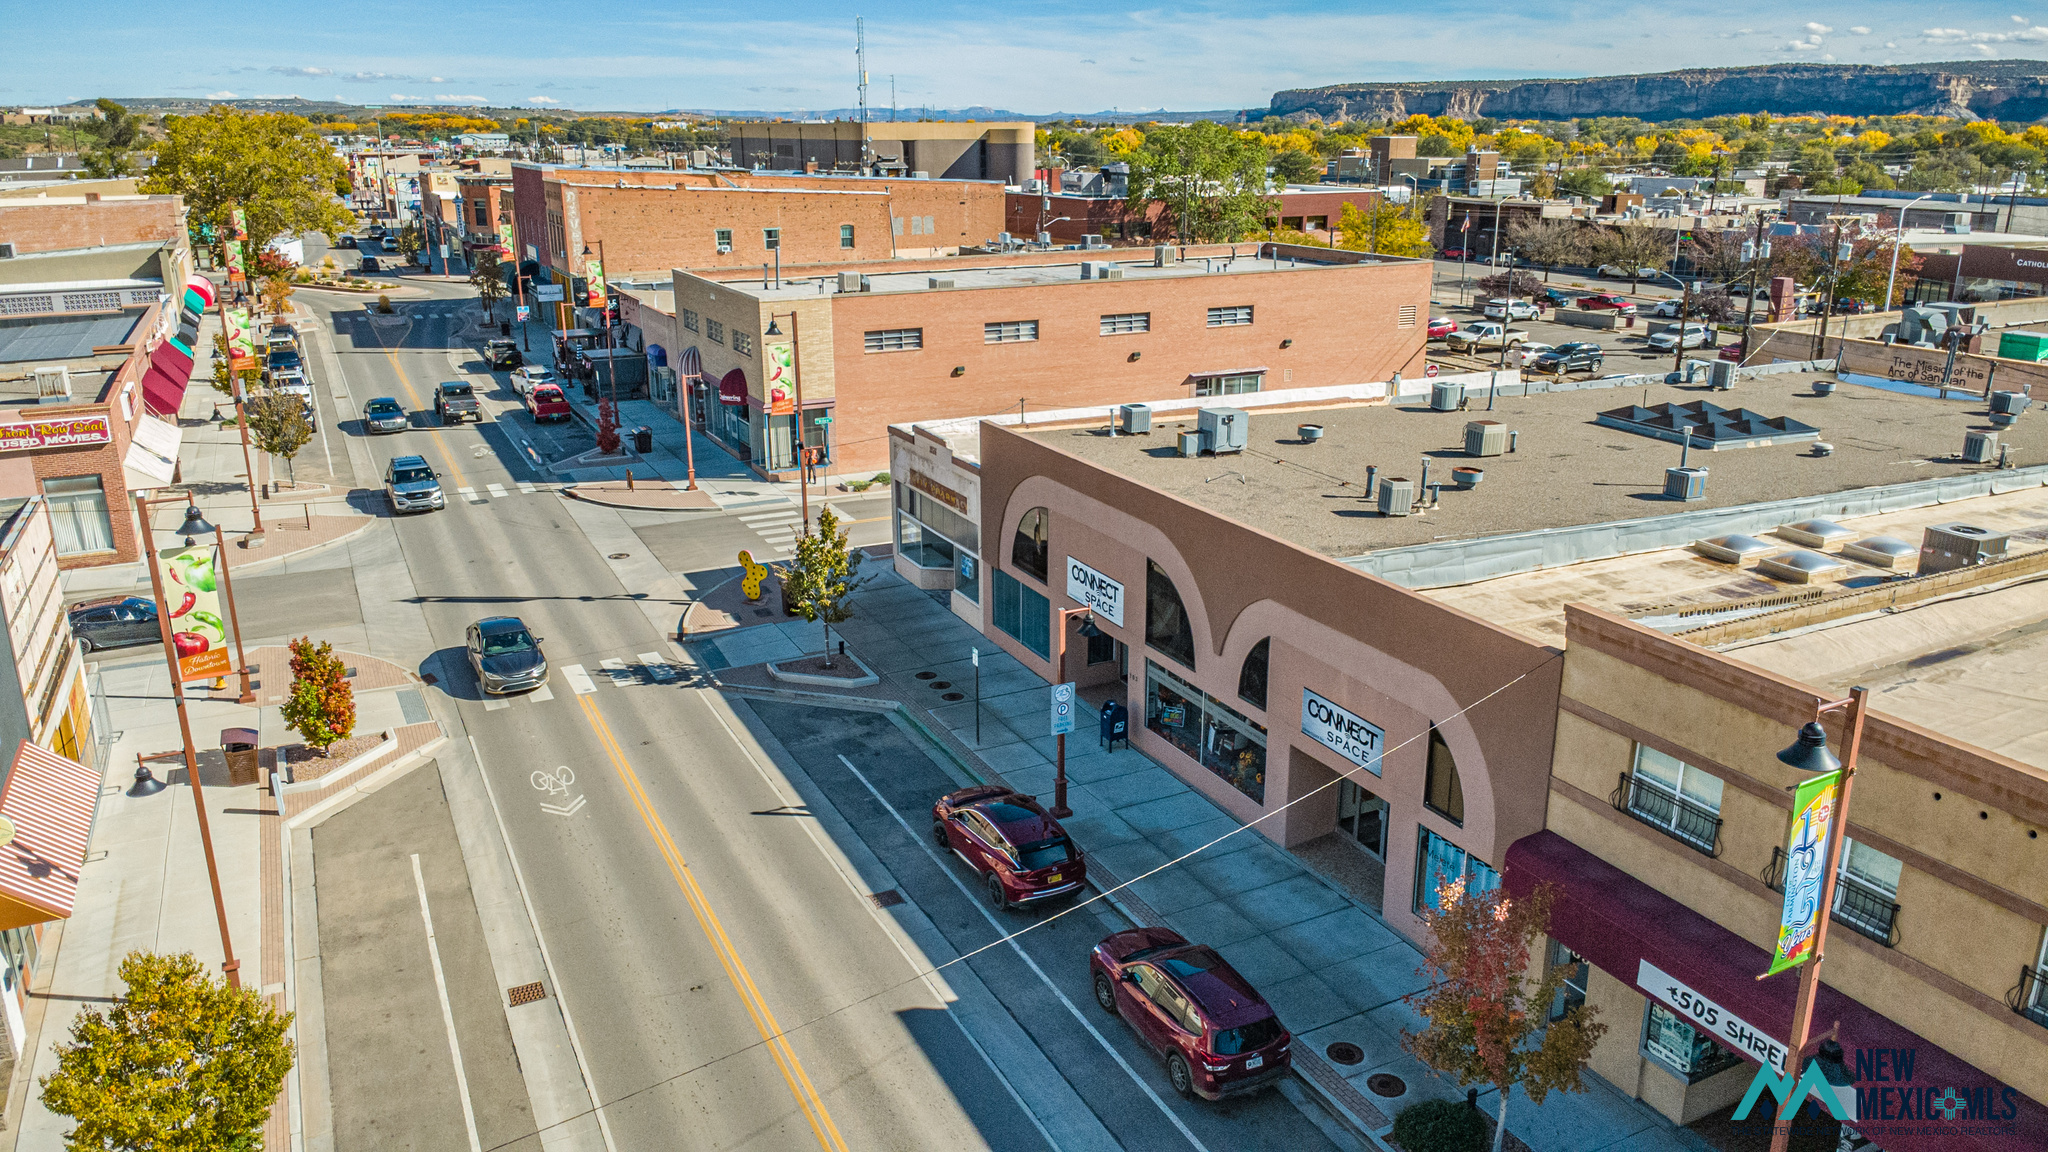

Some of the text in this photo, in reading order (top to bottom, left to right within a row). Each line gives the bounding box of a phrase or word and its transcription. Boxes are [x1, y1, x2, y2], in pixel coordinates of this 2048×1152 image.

[1888, 365, 1905, 377] Arc
[1907, 369, 1919, 380] of
[1920, 371, 1940, 383] San
[1893, 356, 1912, 369] The
[1954, 366, 1966, 376] of
[1966, 367, 1984, 380] the
[0, 432, 101, 449] USED MOVIES
[35, 423, 69, 435] Row
[1071, 564, 1119, 603] CONNECT
[1085, 591, 1115, 617] SPACE
[183, 658, 227, 676] Downtown
[188, 651, 221, 666] Historic
[1307, 698, 1379, 750] CONNECT
[1326, 730, 1369, 764] SPACE
[1786, 859, 1800, 924] FARMINGTON
[1677, 991, 1719, 1026] 505
